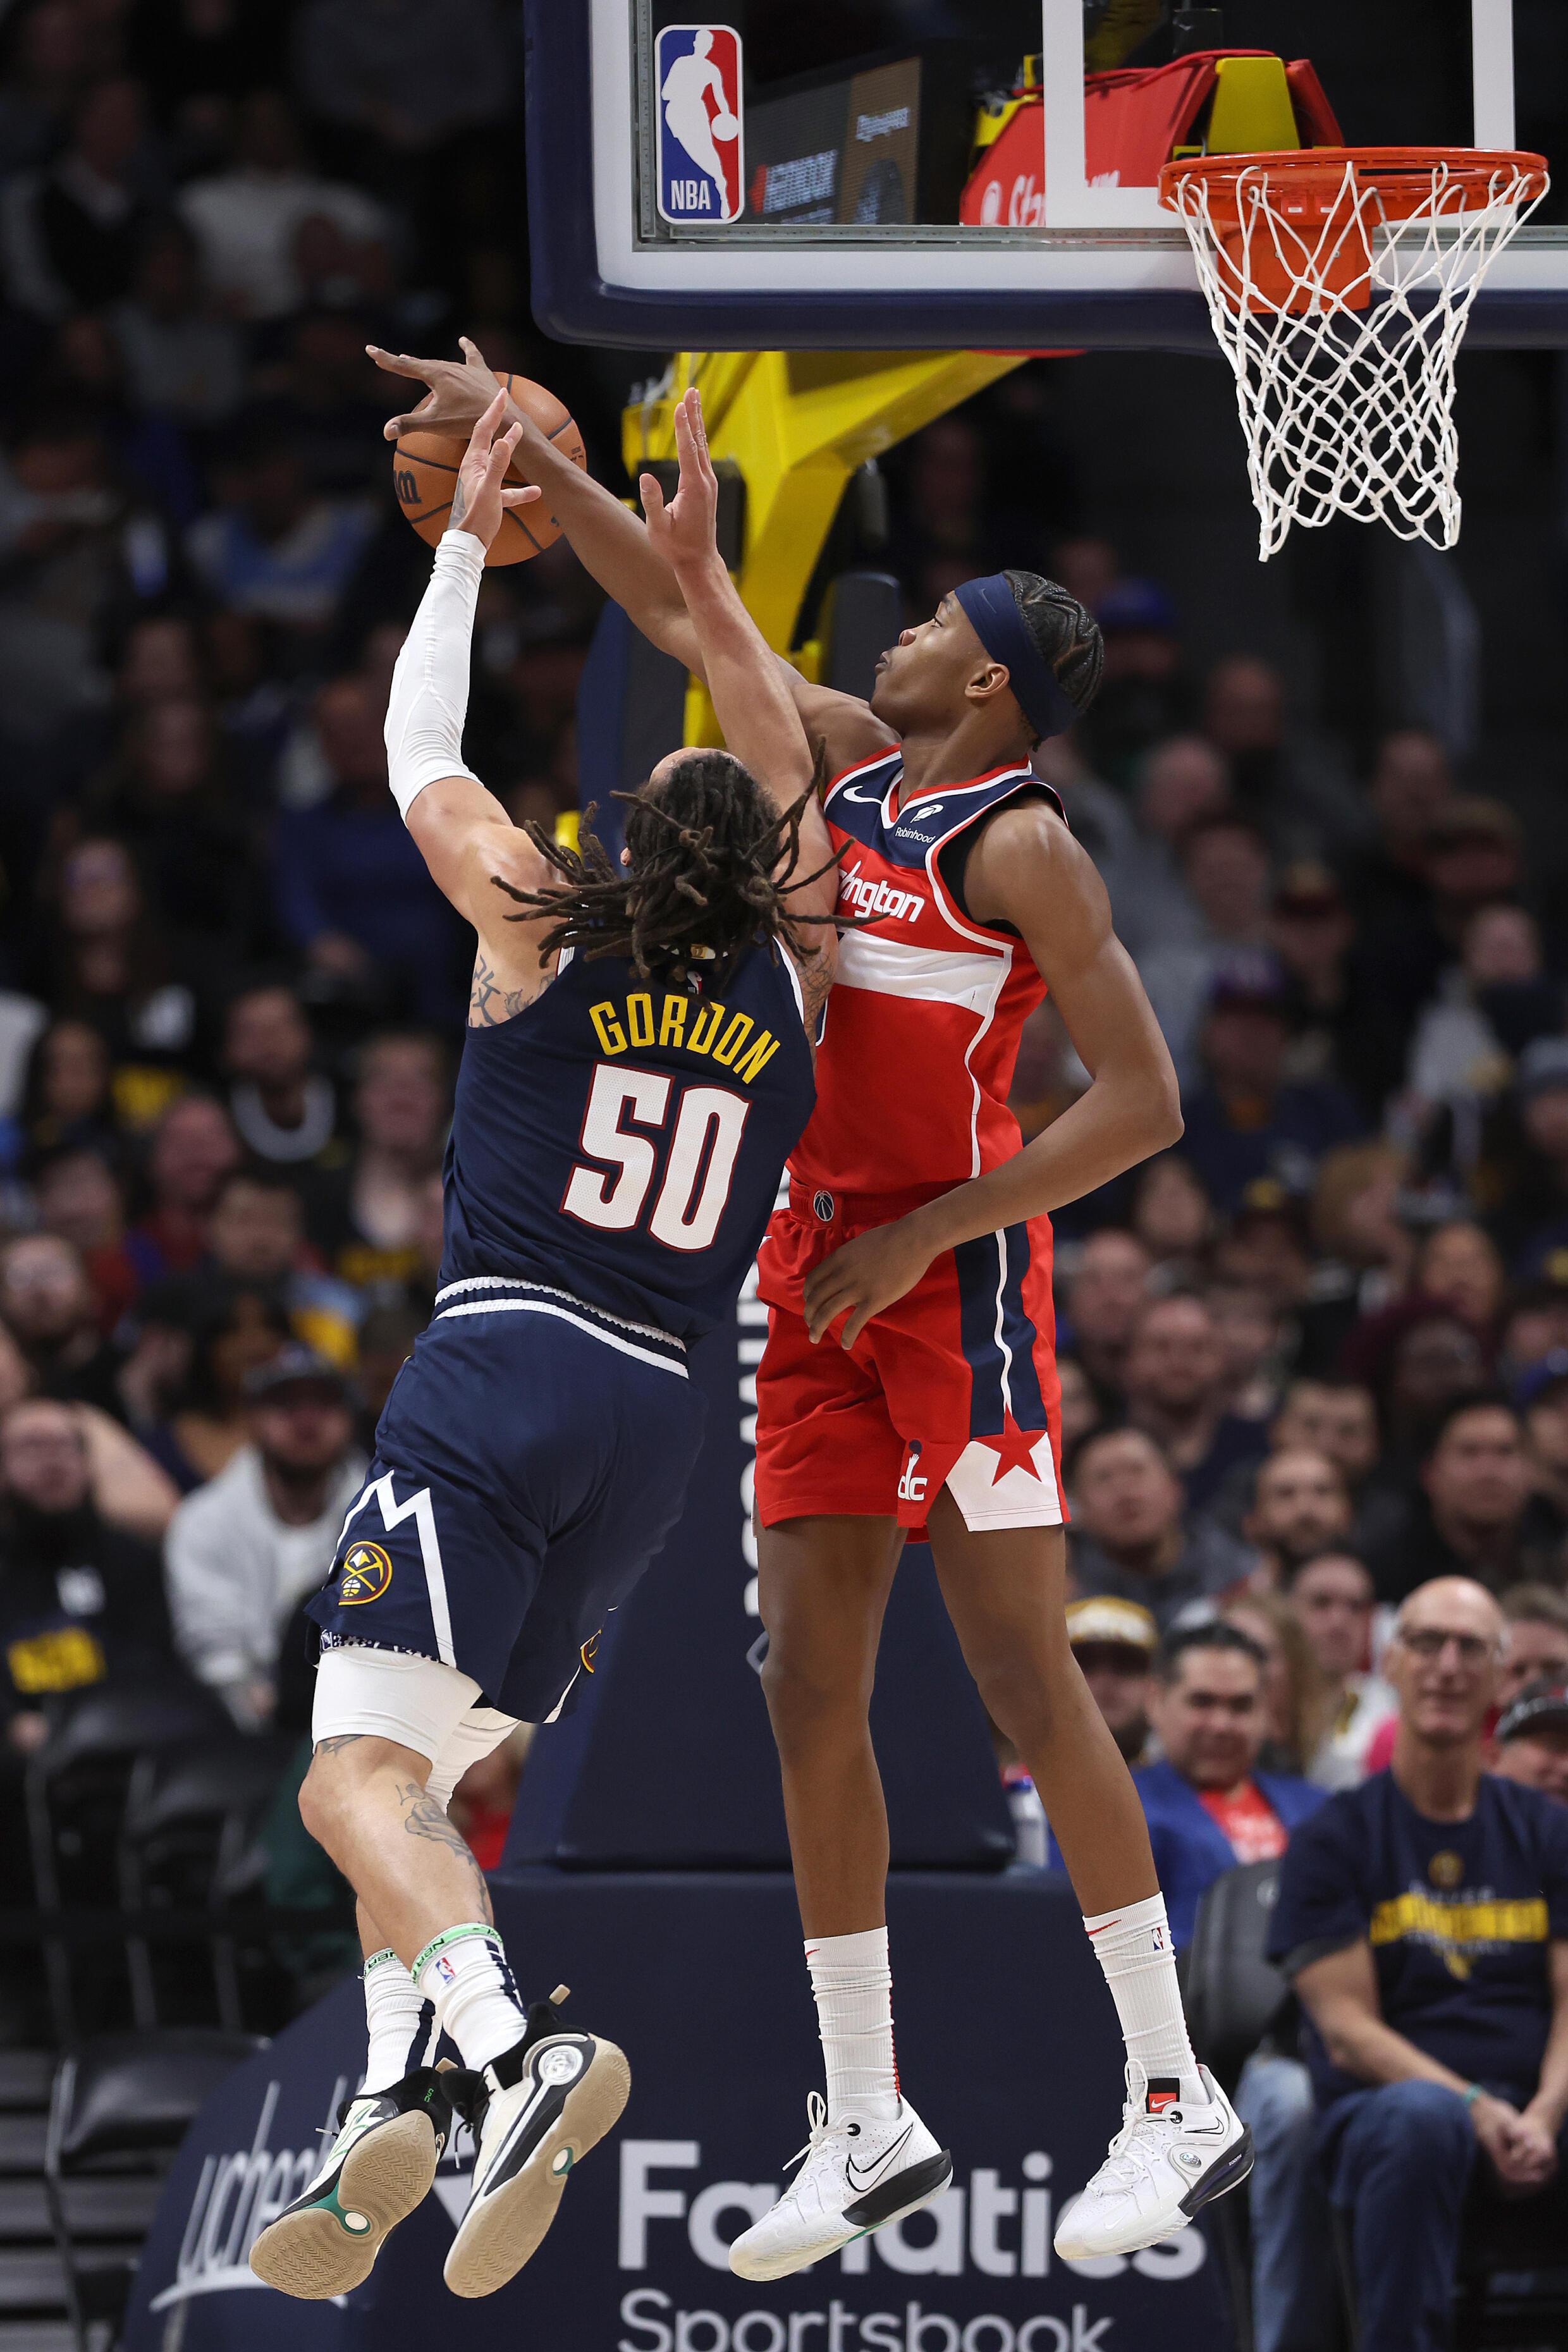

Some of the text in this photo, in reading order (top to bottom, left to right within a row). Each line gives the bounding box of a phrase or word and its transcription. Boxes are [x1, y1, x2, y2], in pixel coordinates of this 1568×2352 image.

[670, 180, 712, 211] NBA
[895, 827, 936, 843] Robinhood
[588, 992, 781, 1085] GORDON
[559, 1060, 753, 1253] 50
[617, 2287, 1115, 2352] Sportsbook
